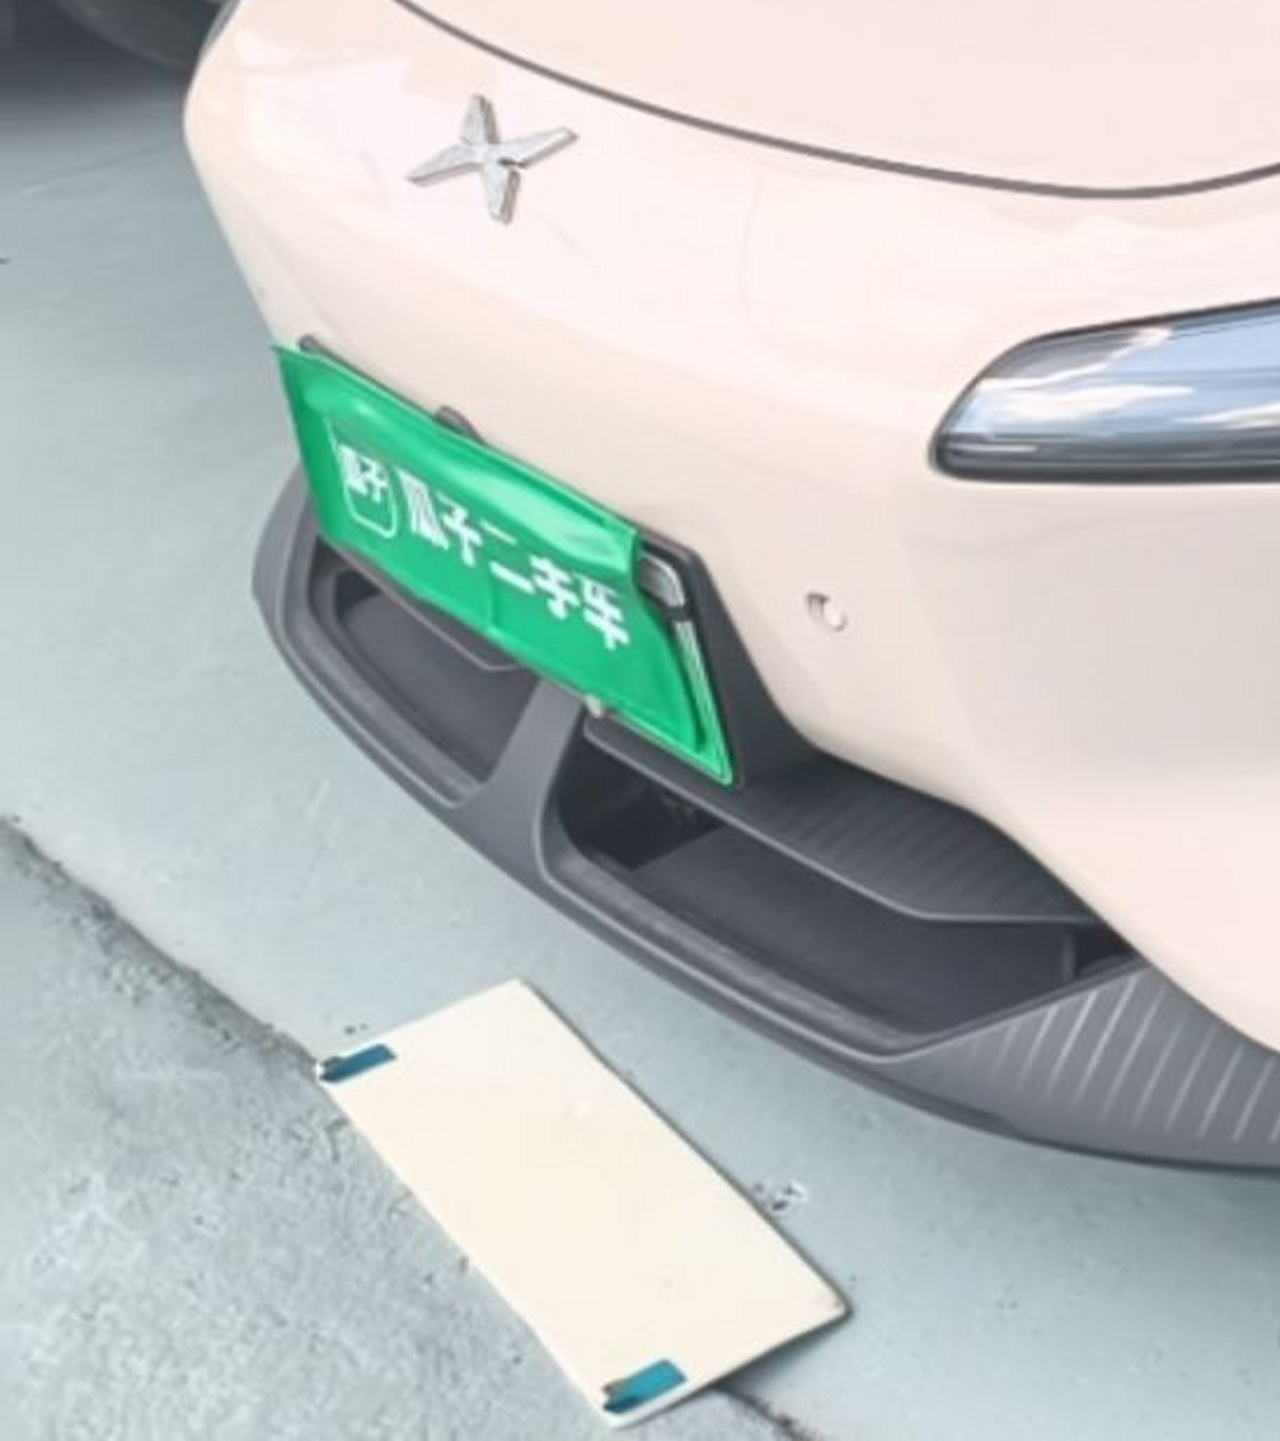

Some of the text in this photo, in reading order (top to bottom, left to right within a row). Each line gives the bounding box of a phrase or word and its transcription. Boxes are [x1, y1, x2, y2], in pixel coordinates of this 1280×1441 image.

[397, 466, 631, 650] 瓜子二手车
